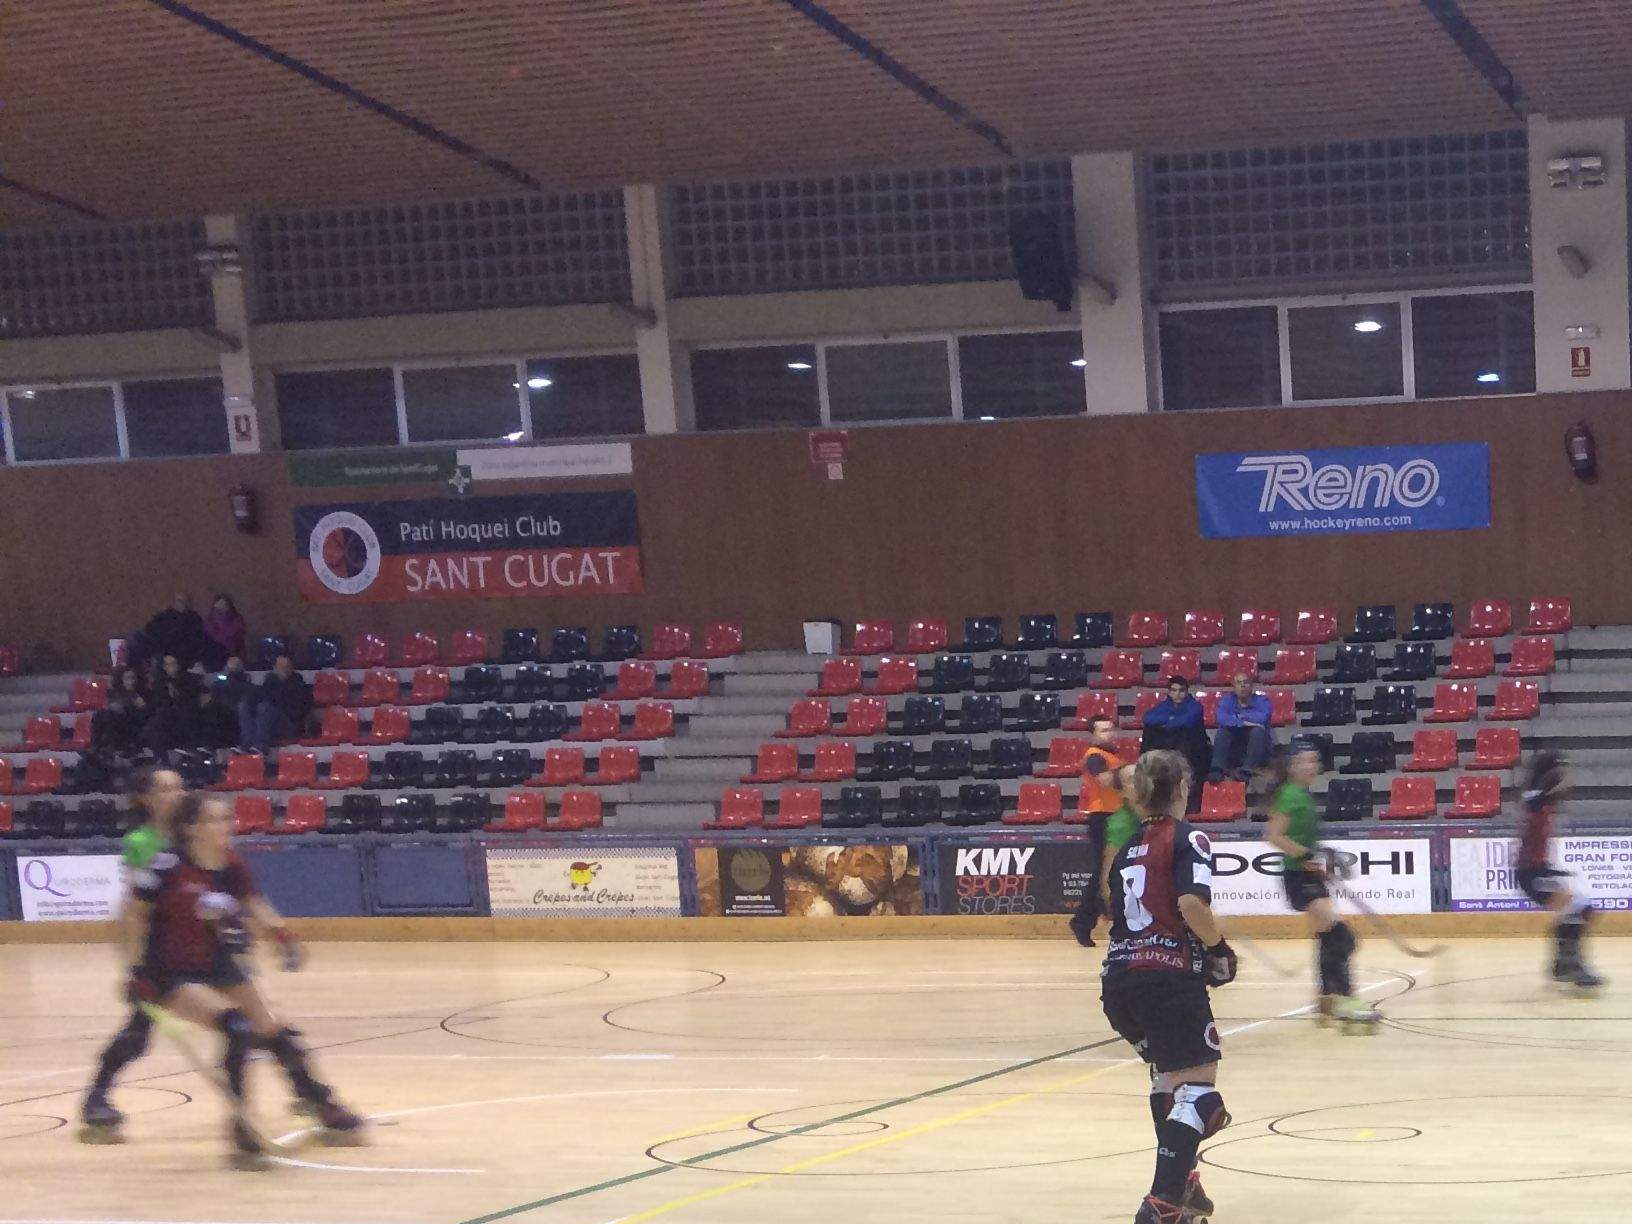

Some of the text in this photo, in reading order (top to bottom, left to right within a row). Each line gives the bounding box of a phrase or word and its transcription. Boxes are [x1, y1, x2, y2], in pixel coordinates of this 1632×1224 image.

[1236, 454, 1441, 513] Reno
[440, 519, 510, 542] Hoquei
[516, 515, 561, 537] Club
[1268, 515, 1412, 531] www.hockeyreno.com
[405, 552, 621, 592] SANT CUGAT
[955, 847, 1036, 876] KMY
[1211, 851, 1415, 877] DEPHI
[1564, 853, 1606, 863] GRAN
[956, 874, 1035, 897] SPORT
[1386, 887, 1416, 900] Real
[957, 895, 1037, 915] STORES
